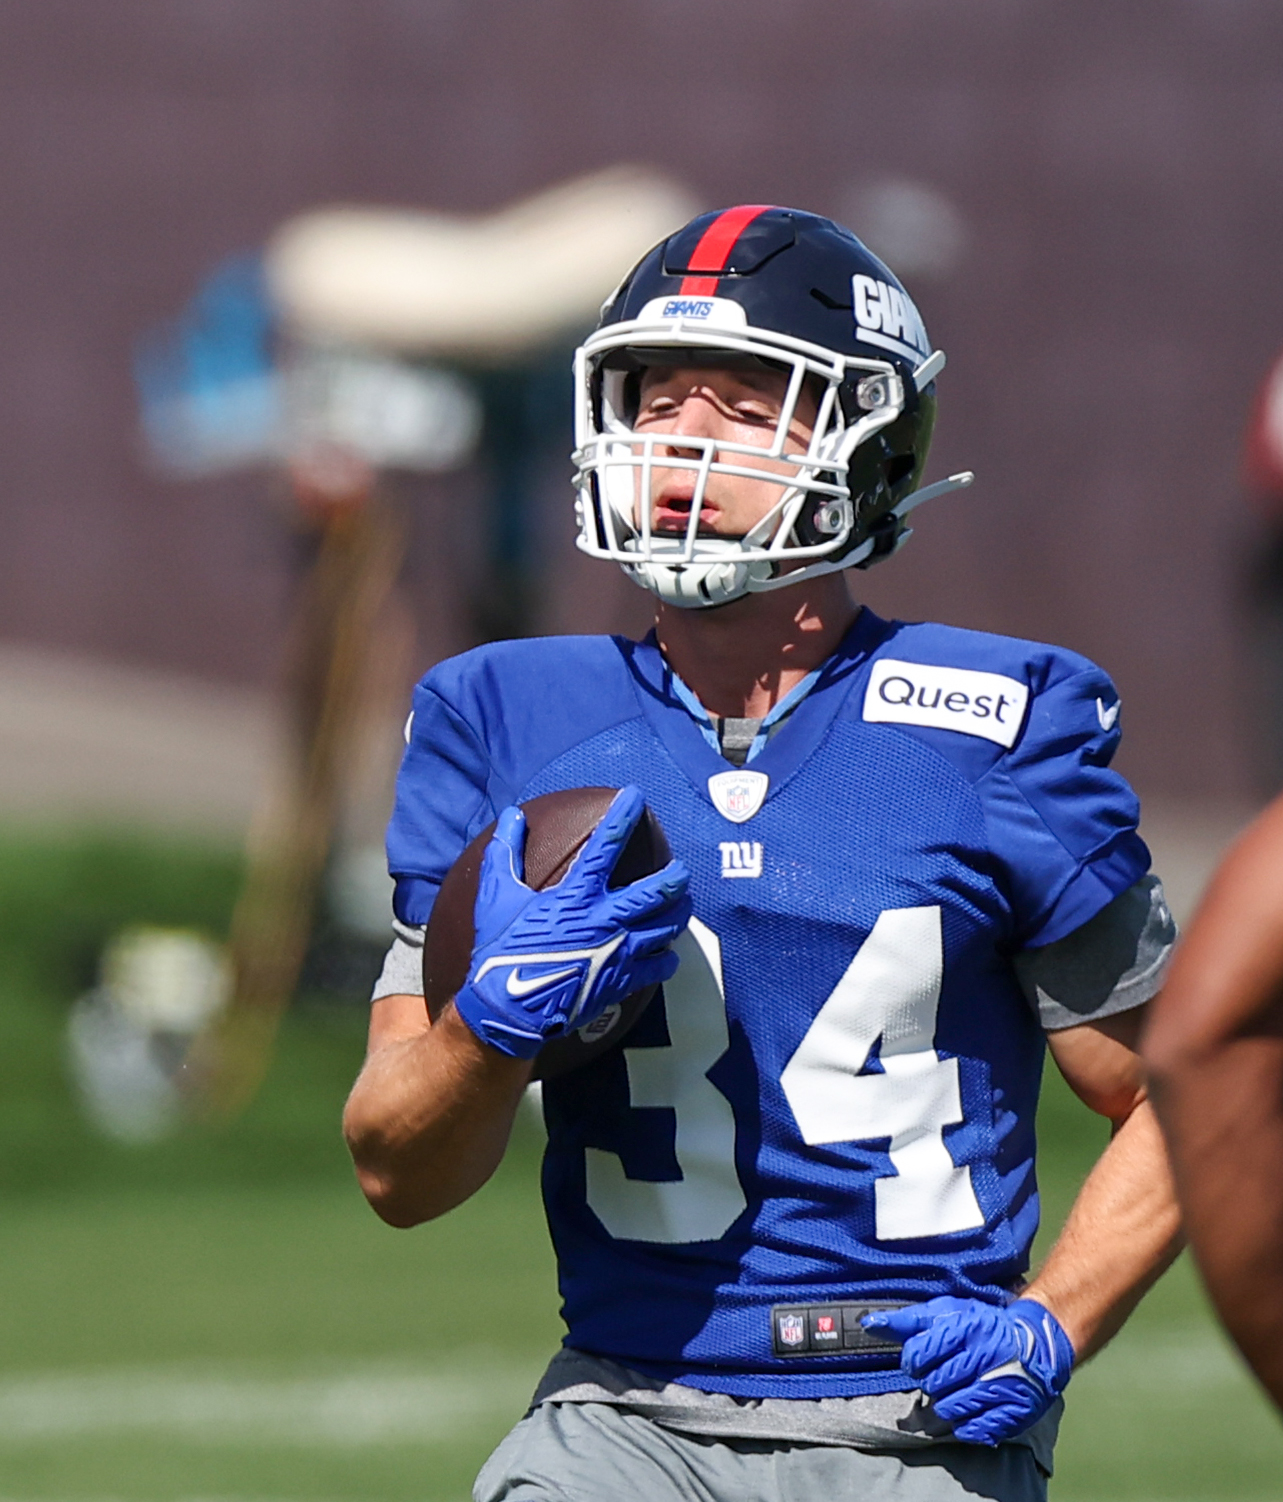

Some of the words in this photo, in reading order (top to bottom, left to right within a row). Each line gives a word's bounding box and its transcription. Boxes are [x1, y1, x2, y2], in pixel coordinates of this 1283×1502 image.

[663, 301, 714, 317] GIANTS
[879, 676, 1011, 724] Quest
[586, 905, 985, 1244] 34
